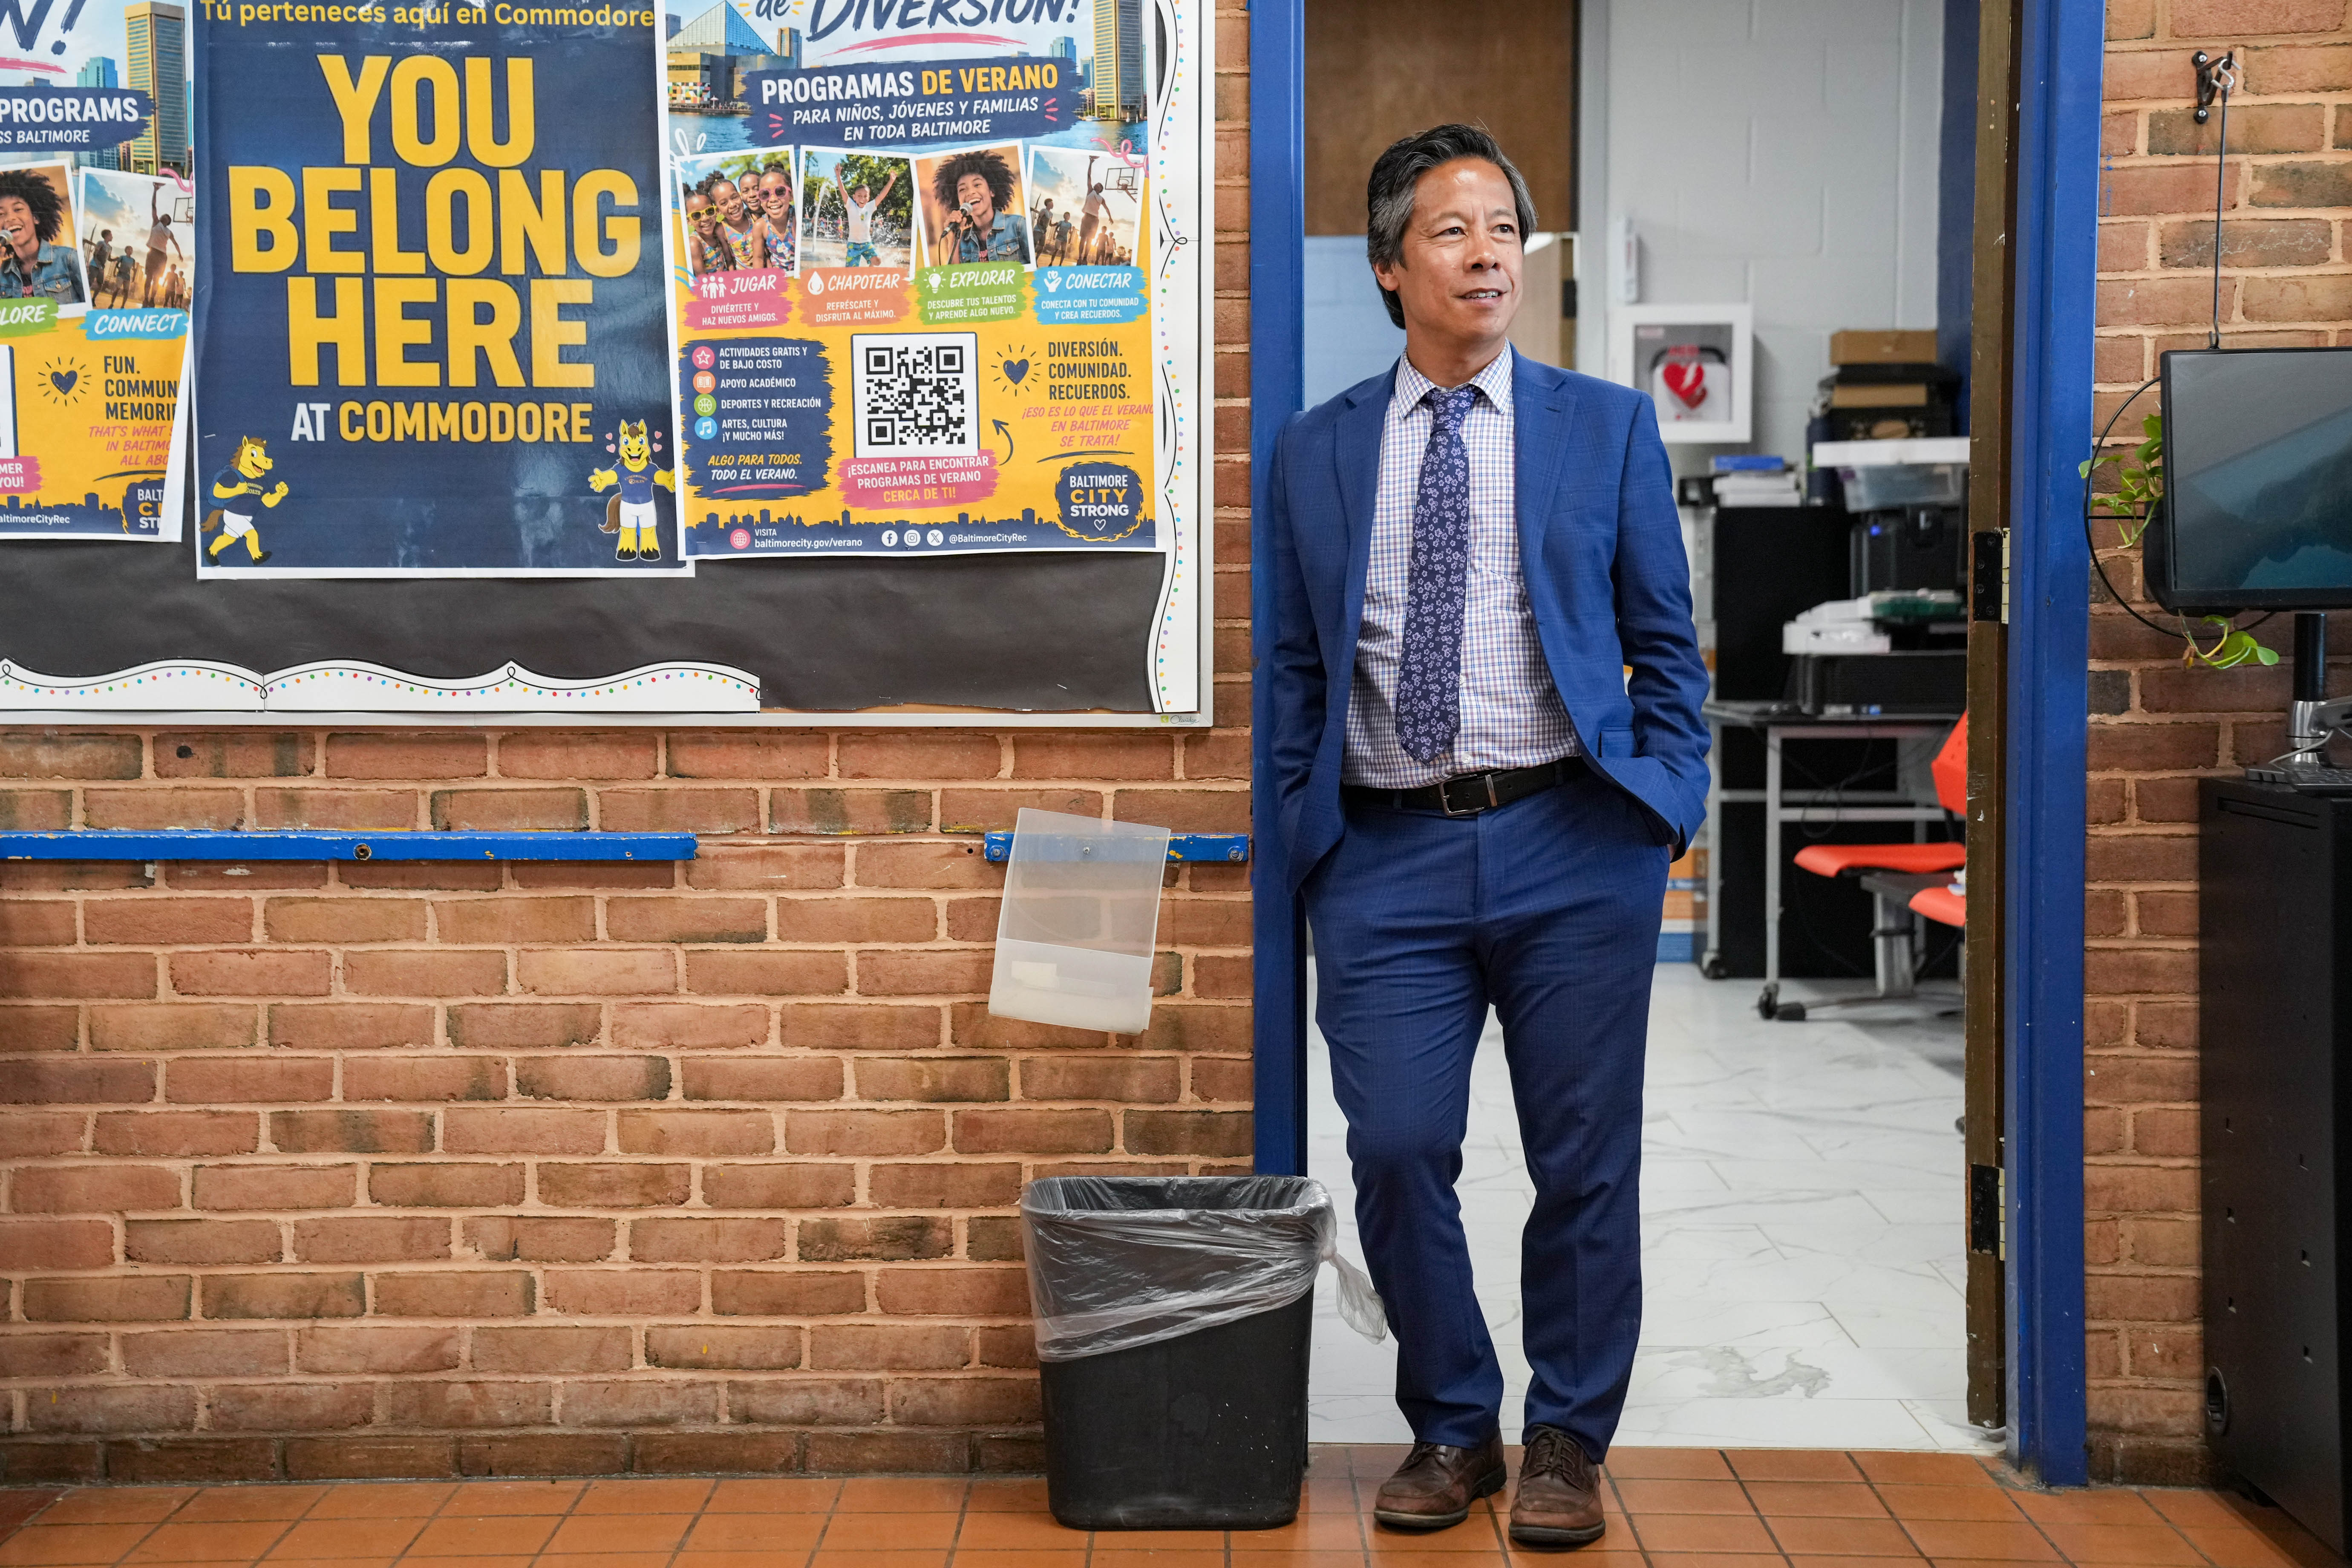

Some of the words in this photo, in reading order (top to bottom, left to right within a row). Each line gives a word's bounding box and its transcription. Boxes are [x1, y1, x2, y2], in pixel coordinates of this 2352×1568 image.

[200, 0, 231, 20] Tú
[240, 1, 386, 26] perteneces
[393, 3, 448, 29] aquí
[456, 7, 487, 24] en
[495, 4, 654, 26] Commodore
[762, 72, 914, 104] PROGRAMAS
[922, 69, 953, 95] DE
[959, 63, 1058, 93] VERANO
[0, 98, 139, 122] PROGRAMS
[317, 55, 536, 167] YOU
[793, 108, 830, 124] PARA
[836, 103, 884, 122] NIÑOS,
[889, 101, 953, 119] JÓVENES
[960, 101, 969, 115] Y
[973, 97, 1038, 114] FAMILIAS
[17, 130, 90, 143] BALTIMORE
[844, 127, 866, 141] EN
[869, 124, 905, 139] TODA
[911, 119, 991, 137] BALTIMORE
[228, 166, 641, 277] BELONG
[730, 275, 776, 295] JUGAR
[828, 274, 900, 291] CHAPOTEAR
[950, 269, 1015, 288] EXPLORAR
[1066, 273, 1132, 289] CONECTAR
[711, 303, 752, 314] DIVIÉRTETE
[754, 303, 759, 311] Y
[827, 300, 873, 311] REFRÉSCATE
[873, 300, 879, 308] Y
[928, 298, 964, 309] DESCUBRE
[966, 297, 980, 306] TUS
[981, 295, 1016, 306] TALENTOS
[1041, 300, 1071, 309] CONECTA
[1073, 299, 1087, 308] CON
[1089, 299, 1098, 307] TU
[1099, 297, 1139, 307] COMUNIDAD
[0, 305, 48, 326] LORE
[702, 317, 716, 325] HAZ
[718, 315, 746, 324] NUEVOS
[748, 313, 778, 323] AMIGOS.
[816, 312, 851, 322] DISFRUTA
[853, 311, 862, 320] AL
[864, 309, 896, 319] MÁXIMO.
[935, 309, 968, 320] APRENDE
[969, 308, 988, 317] ALGO
[990, 306, 1015, 316] NUEVO.
[1061, 311, 1079, 319] CREA
[1080, 309, 1121, 318] RECUERDOS.
[94, 313, 182, 334] CONNECT
[288, 276, 594, 388] HERE
[720, 347, 770, 357] ACTIVIDADES
[772, 347, 800, 356] GRATIS
[801, 347, 807, 356] Y
[1048, 337, 1122, 357] DIVERSIÓN.
[104, 356, 140, 374] FUN.
[720, 360, 731, 369] DE
[733, 360, 754, 369] BAJO
[756, 359, 782, 368] COSTO
[1049, 362, 1131, 379] COMUNIDAD.
[105, 379, 180, 398] COMMUN
[721, 379, 747, 388] APOYO
[749, 376, 796, 388] ACADÉMICO
[1049, 383, 1130, 400] RECUERDOS.
[721, 399, 761, 409] DEPORTES
[764, 399, 770, 408] Y
[771, 396, 821, 409] RECREACIÓN
[1022, 406, 1045, 420] ¡ESO
[1048, 406, 1061, 417] ES
[1064, 406, 1076, 417] LO
[1078, 405, 1099, 416] QUE
[1102, 406, 1113, 415] EL
[291, 402, 331, 441] AT
[338, 401, 593, 442] COMMODORE
[722, 419, 749, 429] ARTES,
[752, 419, 787, 428] CULTURA
[1051, 421, 1066, 432] EN
[1069, 419, 1131, 431] BALTIMORE
[89, 426, 128, 437] THAT'S
[132, 425, 166, 437] WHAT
[722, 432, 731, 443] ¡Y
[733, 431, 762, 441] MUCHO
[764, 429, 784, 440] MÁS!
[106, 441, 119, 451] IN
[1060, 435, 1075, 447] SE
[1079, 434, 1120, 446] TRATA!
[121, 455, 140, 465] ALL
[708, 455, 734, 466] ALGO
[738, 455, 764, 465] PARA
[768, 454, 802, 464] TODOS.
[847, 462, 896, 478] ¡ESCANEA
[900, 461, 926, 471] PARA
[930, 456, 989, 470] ENCONTRAR
[711, 469, 737, 480] TODO
[740, 469, 752, 479] EL
[755, 468, 797, 479] VERANO.
[857, 475, 920, 489] PROGRAMAS
[924, 474, 937, 484] DE
[940, 470, 981, 483] VERANO
[1069, 475, 1128, 487] BALTIMORE
[883, 489, 919, 502] CERCA
[924, 488, 938, 499] DE
[942, 487, 956, 499] TI!
[1070, 489, 1127, 503] CITY
[1070, 504, 1129, 517] STRONG
[755, 538, 862, 549] baltimorecity.gov/verano
[949, 533, 1027, 544] @BaltimoreCityRec
